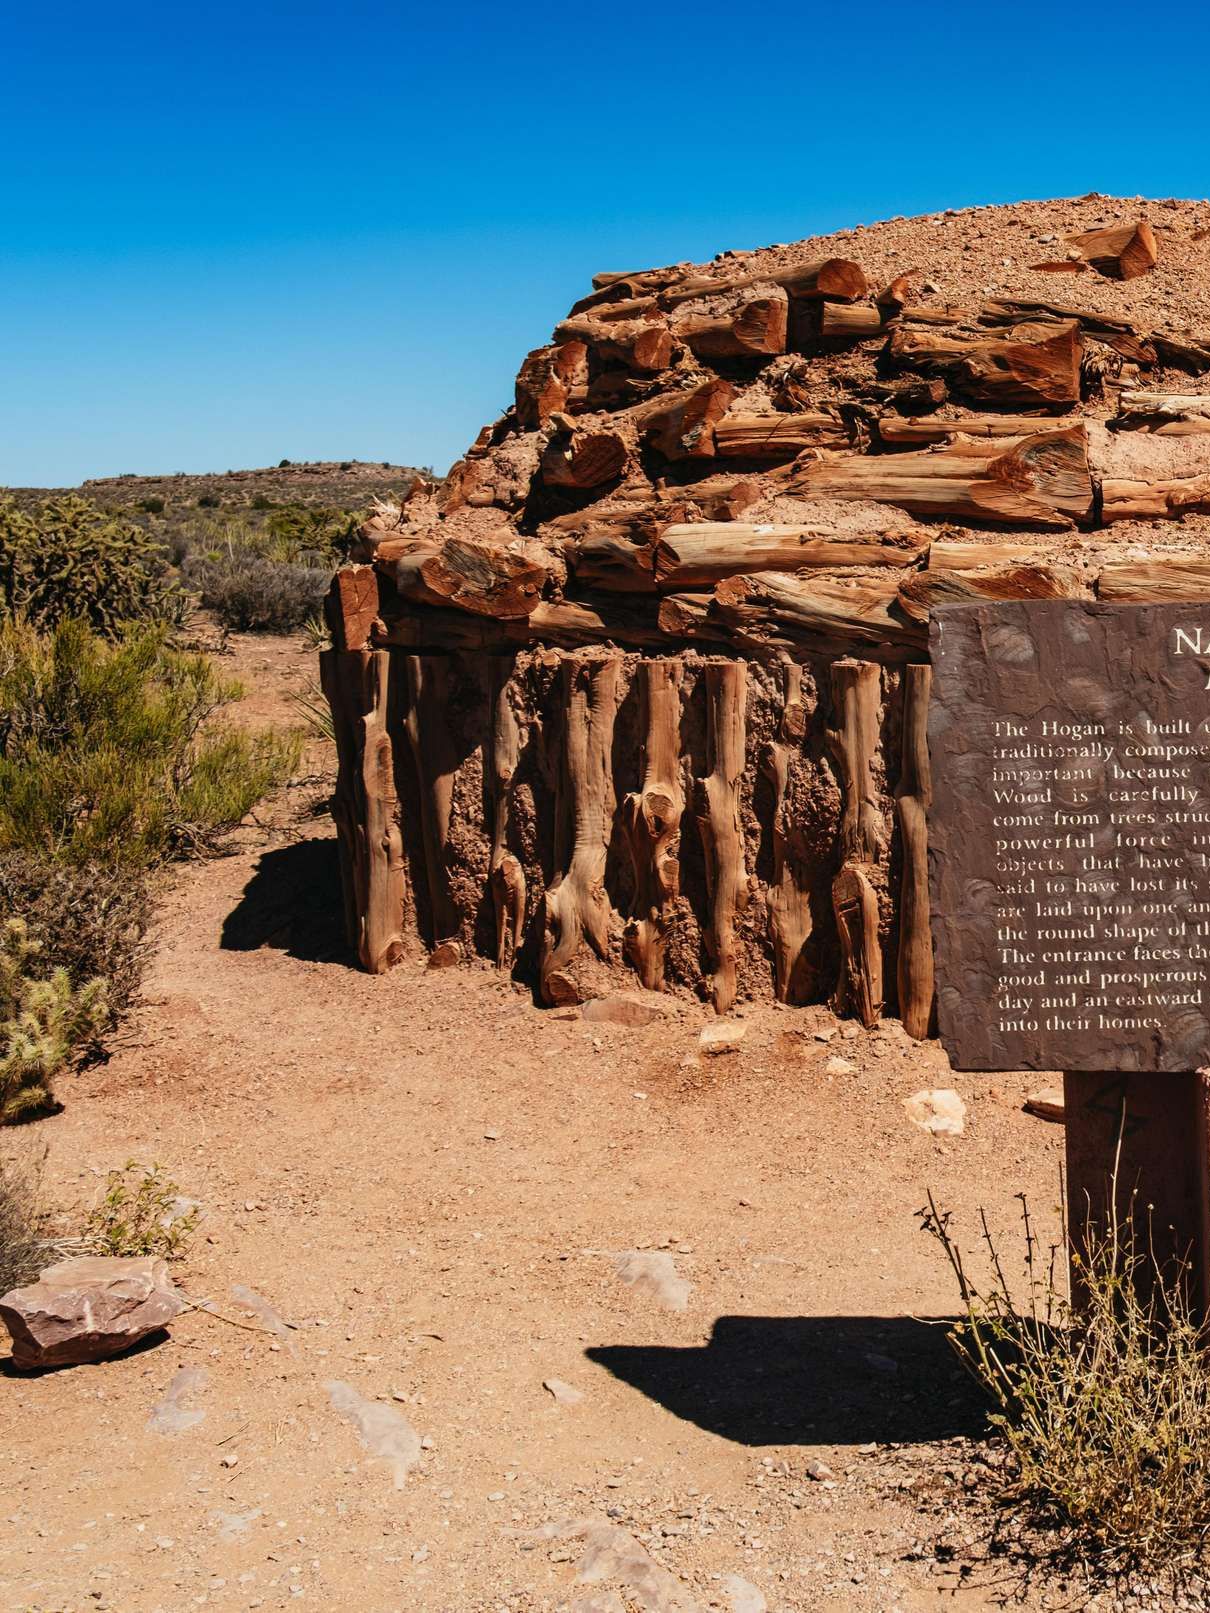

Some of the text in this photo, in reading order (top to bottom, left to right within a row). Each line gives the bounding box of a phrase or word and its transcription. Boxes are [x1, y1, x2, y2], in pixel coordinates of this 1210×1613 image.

[991, 721, 1028, 737] The
[1042, 721, 1105, 740] Hogan
[1119, 720, 1133, 735] is
[1146, 719, 1192, 735] built
[992, 742, 1113, 761] traditionally
[992, 767, 1094, 786] important
[1114, 764, 1191, 779] because
[992, 789, 1051, 804] Wood
[1073, 788, 1088, 803] is
[1109, 784, 1199, 806] carefully
[993, 814, 1044, 827] come
[1054, 810, 1099, 825] from
[1110, 812, 1155, 824] trees
[996, 834, 1095, 855] powerful
[1116, 832, 1171, 848] force
[996, 858, 1065, 876] objects
[1083, 856, 1120, 870] that
[1139, 855, 1184, 868] have
[997, 880, 1035, 894] said
[1046, 881, 1065, 893] to
[1075, 879, 1120, 893] have
[1130, 877, 1165, 891] lost
[1175, 877, 1198, 890] its
[997, 905, 1026, 918] are
[1036, 902, 1072, 917] laid
[1084, 904, 1132, 921] upon
[1143, 902, 1177, 915] one
[998, 927, 1027, 940] the
[1037, 924, 1094, 940] round
[1104, 924, 1159, 942] shape
[1168, 922, 1186, 936] of
[998, 948, 1035, 964] The
[1043, 948, 1126, 963] entrance
[1134, 945, 1180, 960] faces
[998, 972, 1044, 992] good
[1055, 970, 1090, 986] and
[1100, 970, 1207, 989] prosperous
[999, 994, 1033, 1015] day
[1041, 993, 1076, 1009] and
[1085, 995, 1108, 1007] an
[1116, 991, 1201, 1007] eastward
[999, 1015, 1168, 1033] into their homes.
